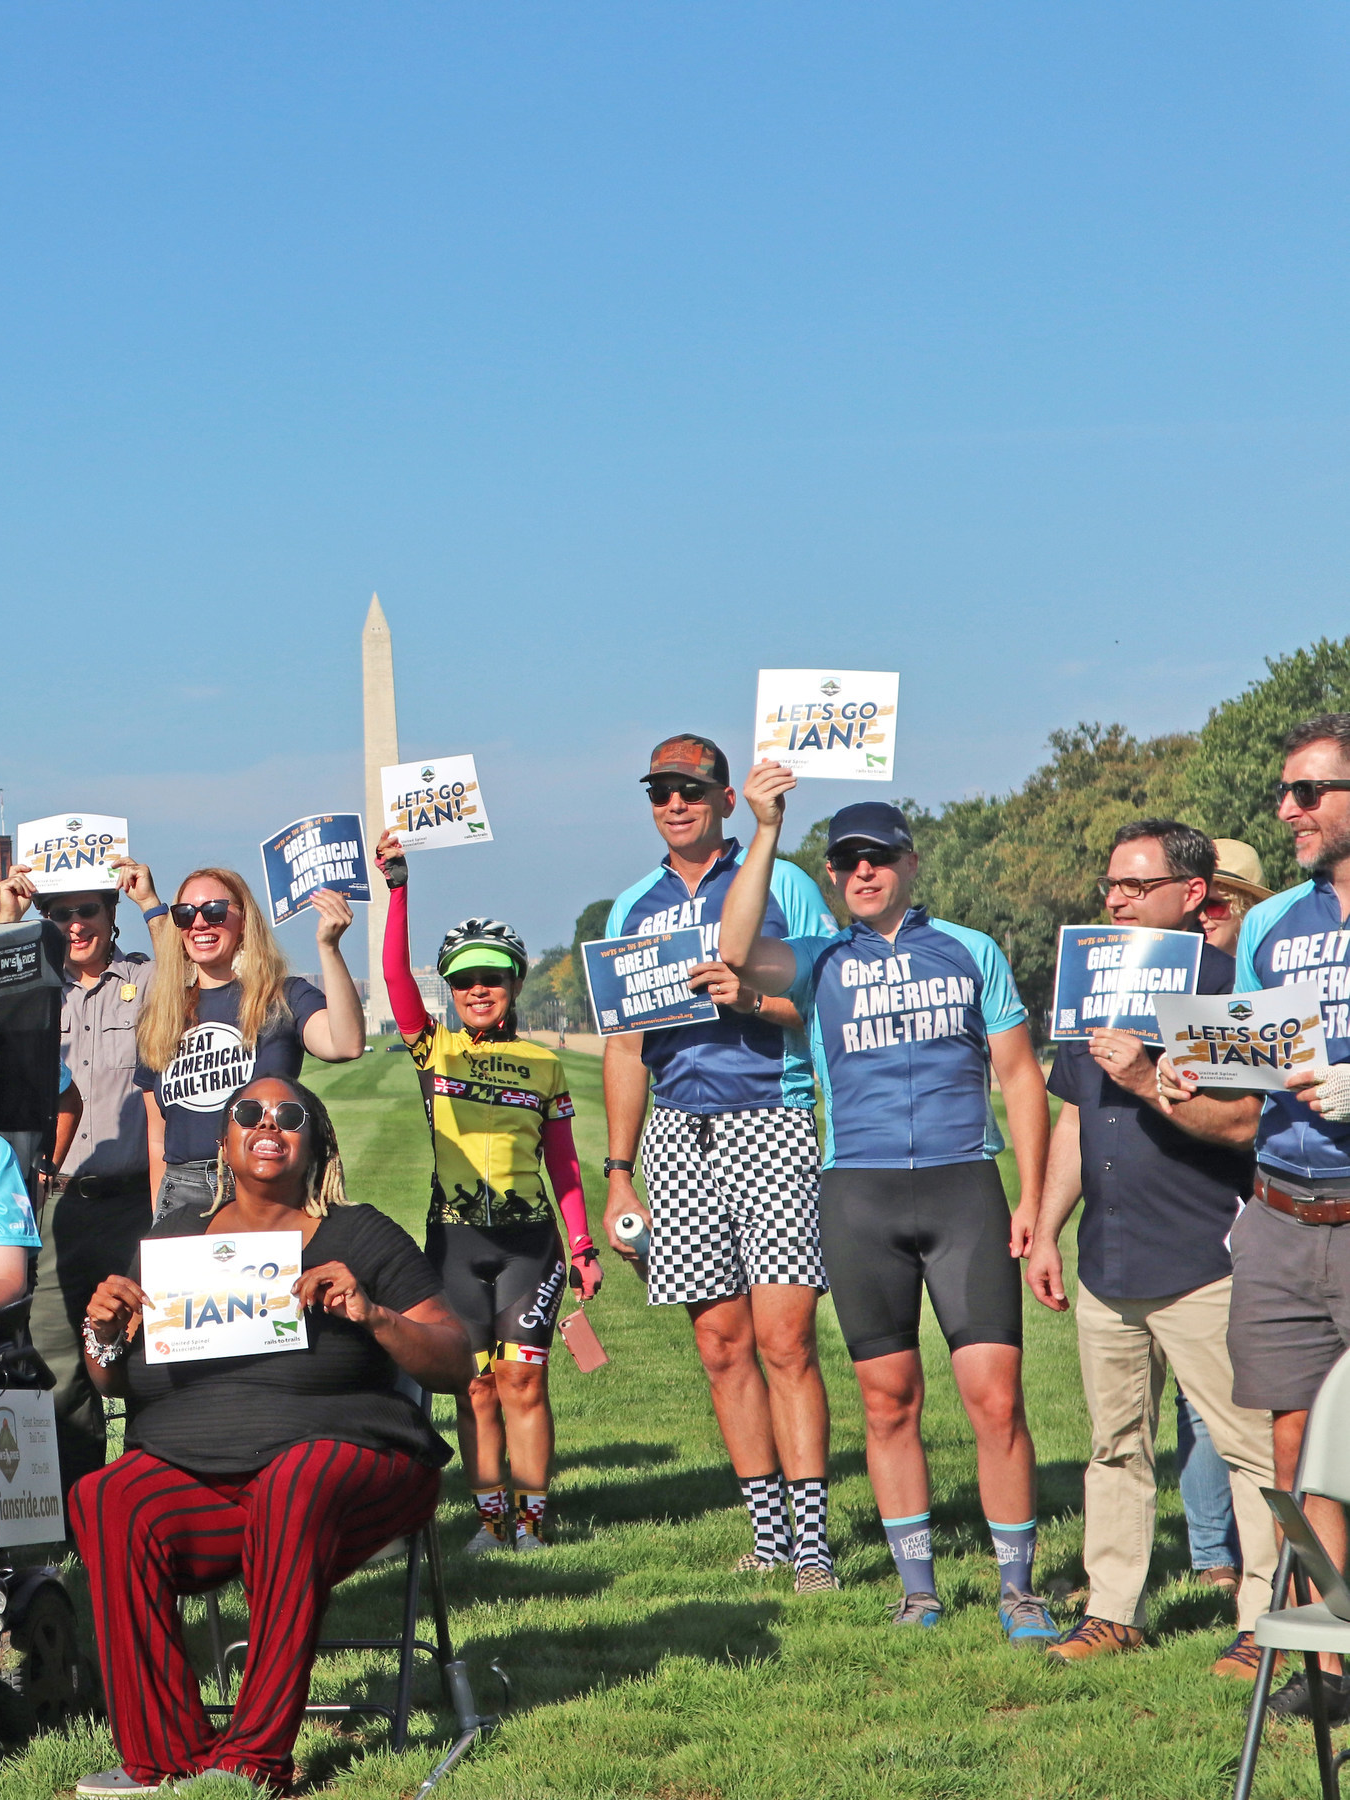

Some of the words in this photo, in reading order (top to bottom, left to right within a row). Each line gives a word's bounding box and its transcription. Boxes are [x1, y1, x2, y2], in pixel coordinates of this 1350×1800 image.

[777, 703, 835, 722] LET'S
[841, 701, 878, 720] GO
[788, 722, 867, 752] IAN!
[397, 787, 435, 810] LET'S
[439, 781, 465, 800] GO
[408, 799, 463, 832] IAN!
[34, 836, 78, 854] LET'S
[85, 834, 113, 847] GO
[45, 846, 106, 873] IAN!
[283, 827, 321, 864] GREAT
[292, 840, 359, 879] AMERICAN
[290, 861, 356, 901] RAIL-TRAIL
[638, 897, 707, 936] GREAT
[614, 946, 659, 977] GREAT
[1271, 929, 1350, 973] GREAT
[841, 953, 912, 988] GREAT
[853, 976, 976, 1019] AMERICAN
[176, 1032, 214, 1059] REAT
[842, 1007, 968, 1054] RAIL-TRAIL
[1188, 1024, 1251, 1043] LET'S
[1259, 1018, 1302, 1042] GO
[1209, 1041, 1293, 1070] IAN!
[162, 1064, 247, 1104] RAIL-TRAIL
[185, 1292, 268, 1330] IAN!
[518, 1260, 565, 1329] Cycling
